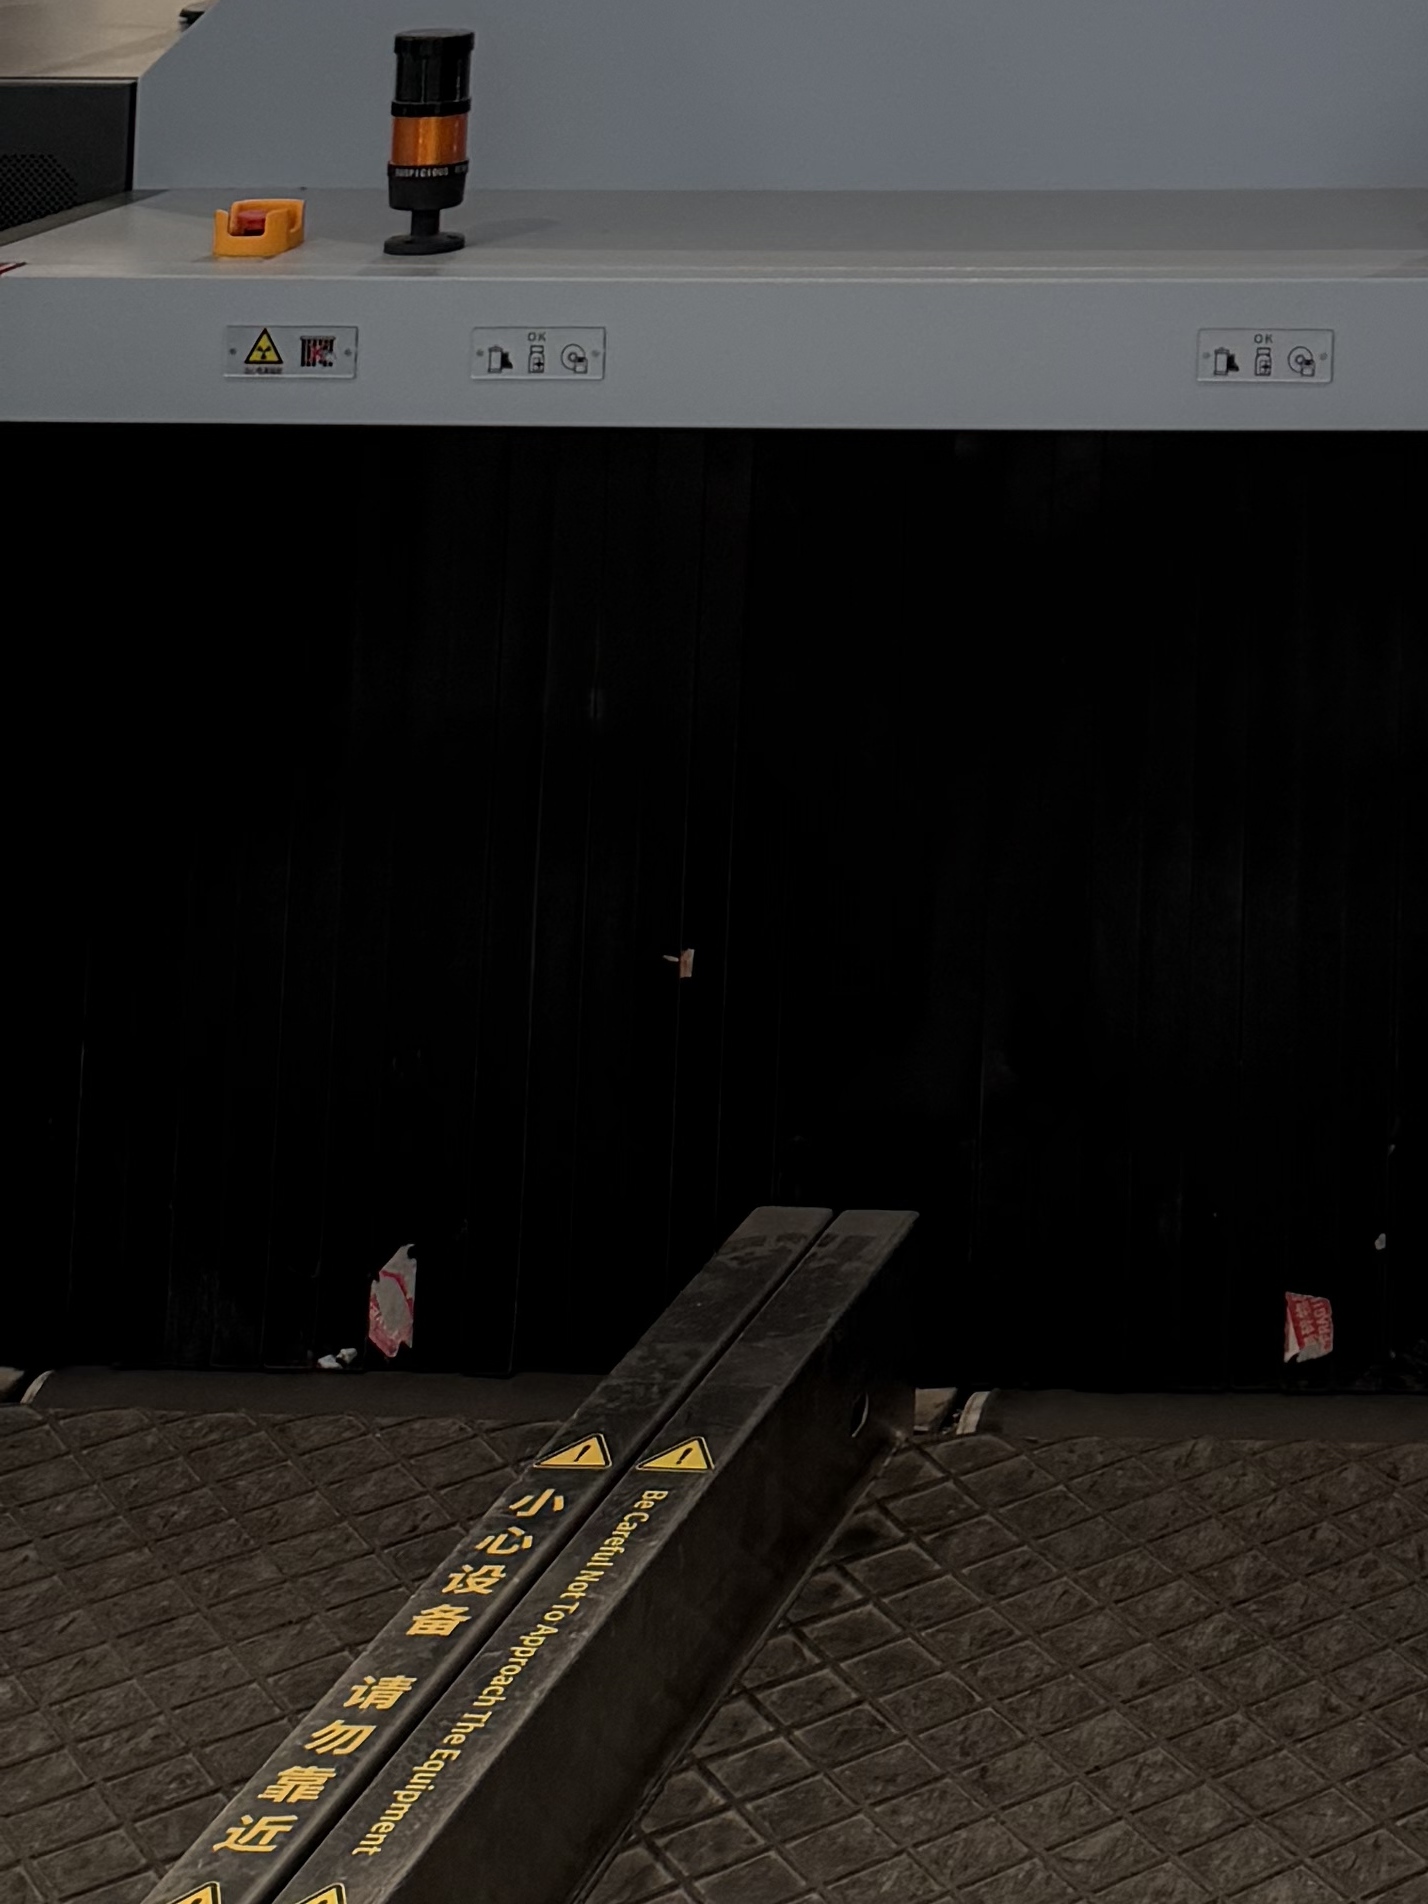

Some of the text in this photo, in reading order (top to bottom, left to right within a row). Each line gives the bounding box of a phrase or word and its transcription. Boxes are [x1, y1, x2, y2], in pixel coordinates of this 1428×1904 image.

[527, 331, 547, 342] OK
[1253, 333, 1273, 344] OK
[212, 1488, 565, 1854] 小心设备 请勿靠近
[351, 1490, 668, 1856] Be Careful Not To Approach The Equipment
